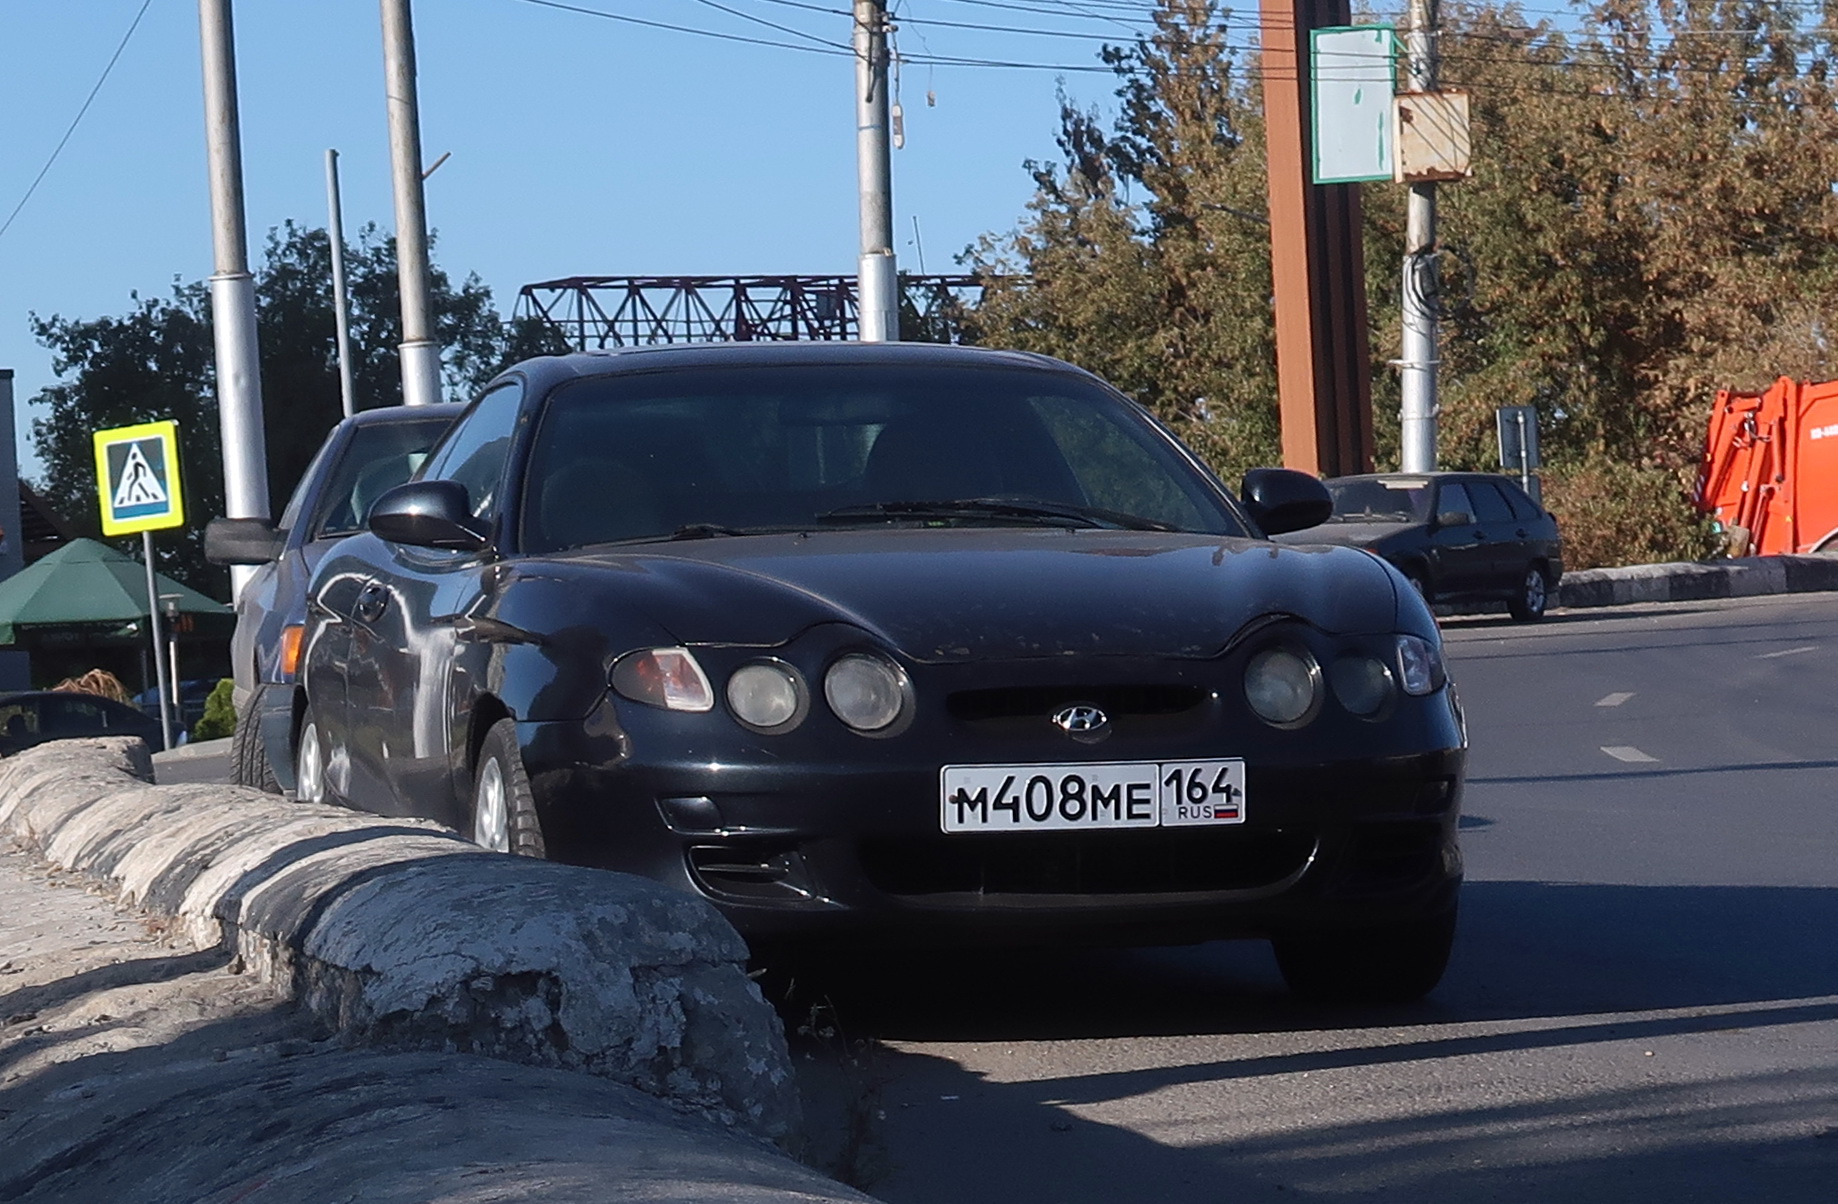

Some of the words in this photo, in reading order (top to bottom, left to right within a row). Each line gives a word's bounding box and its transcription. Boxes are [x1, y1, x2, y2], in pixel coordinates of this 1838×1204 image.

[956, 774, 1152, 823] M408ME
[1164, 767, 1232, 805] 164
[1178, 806, 1212, 819] RUS
